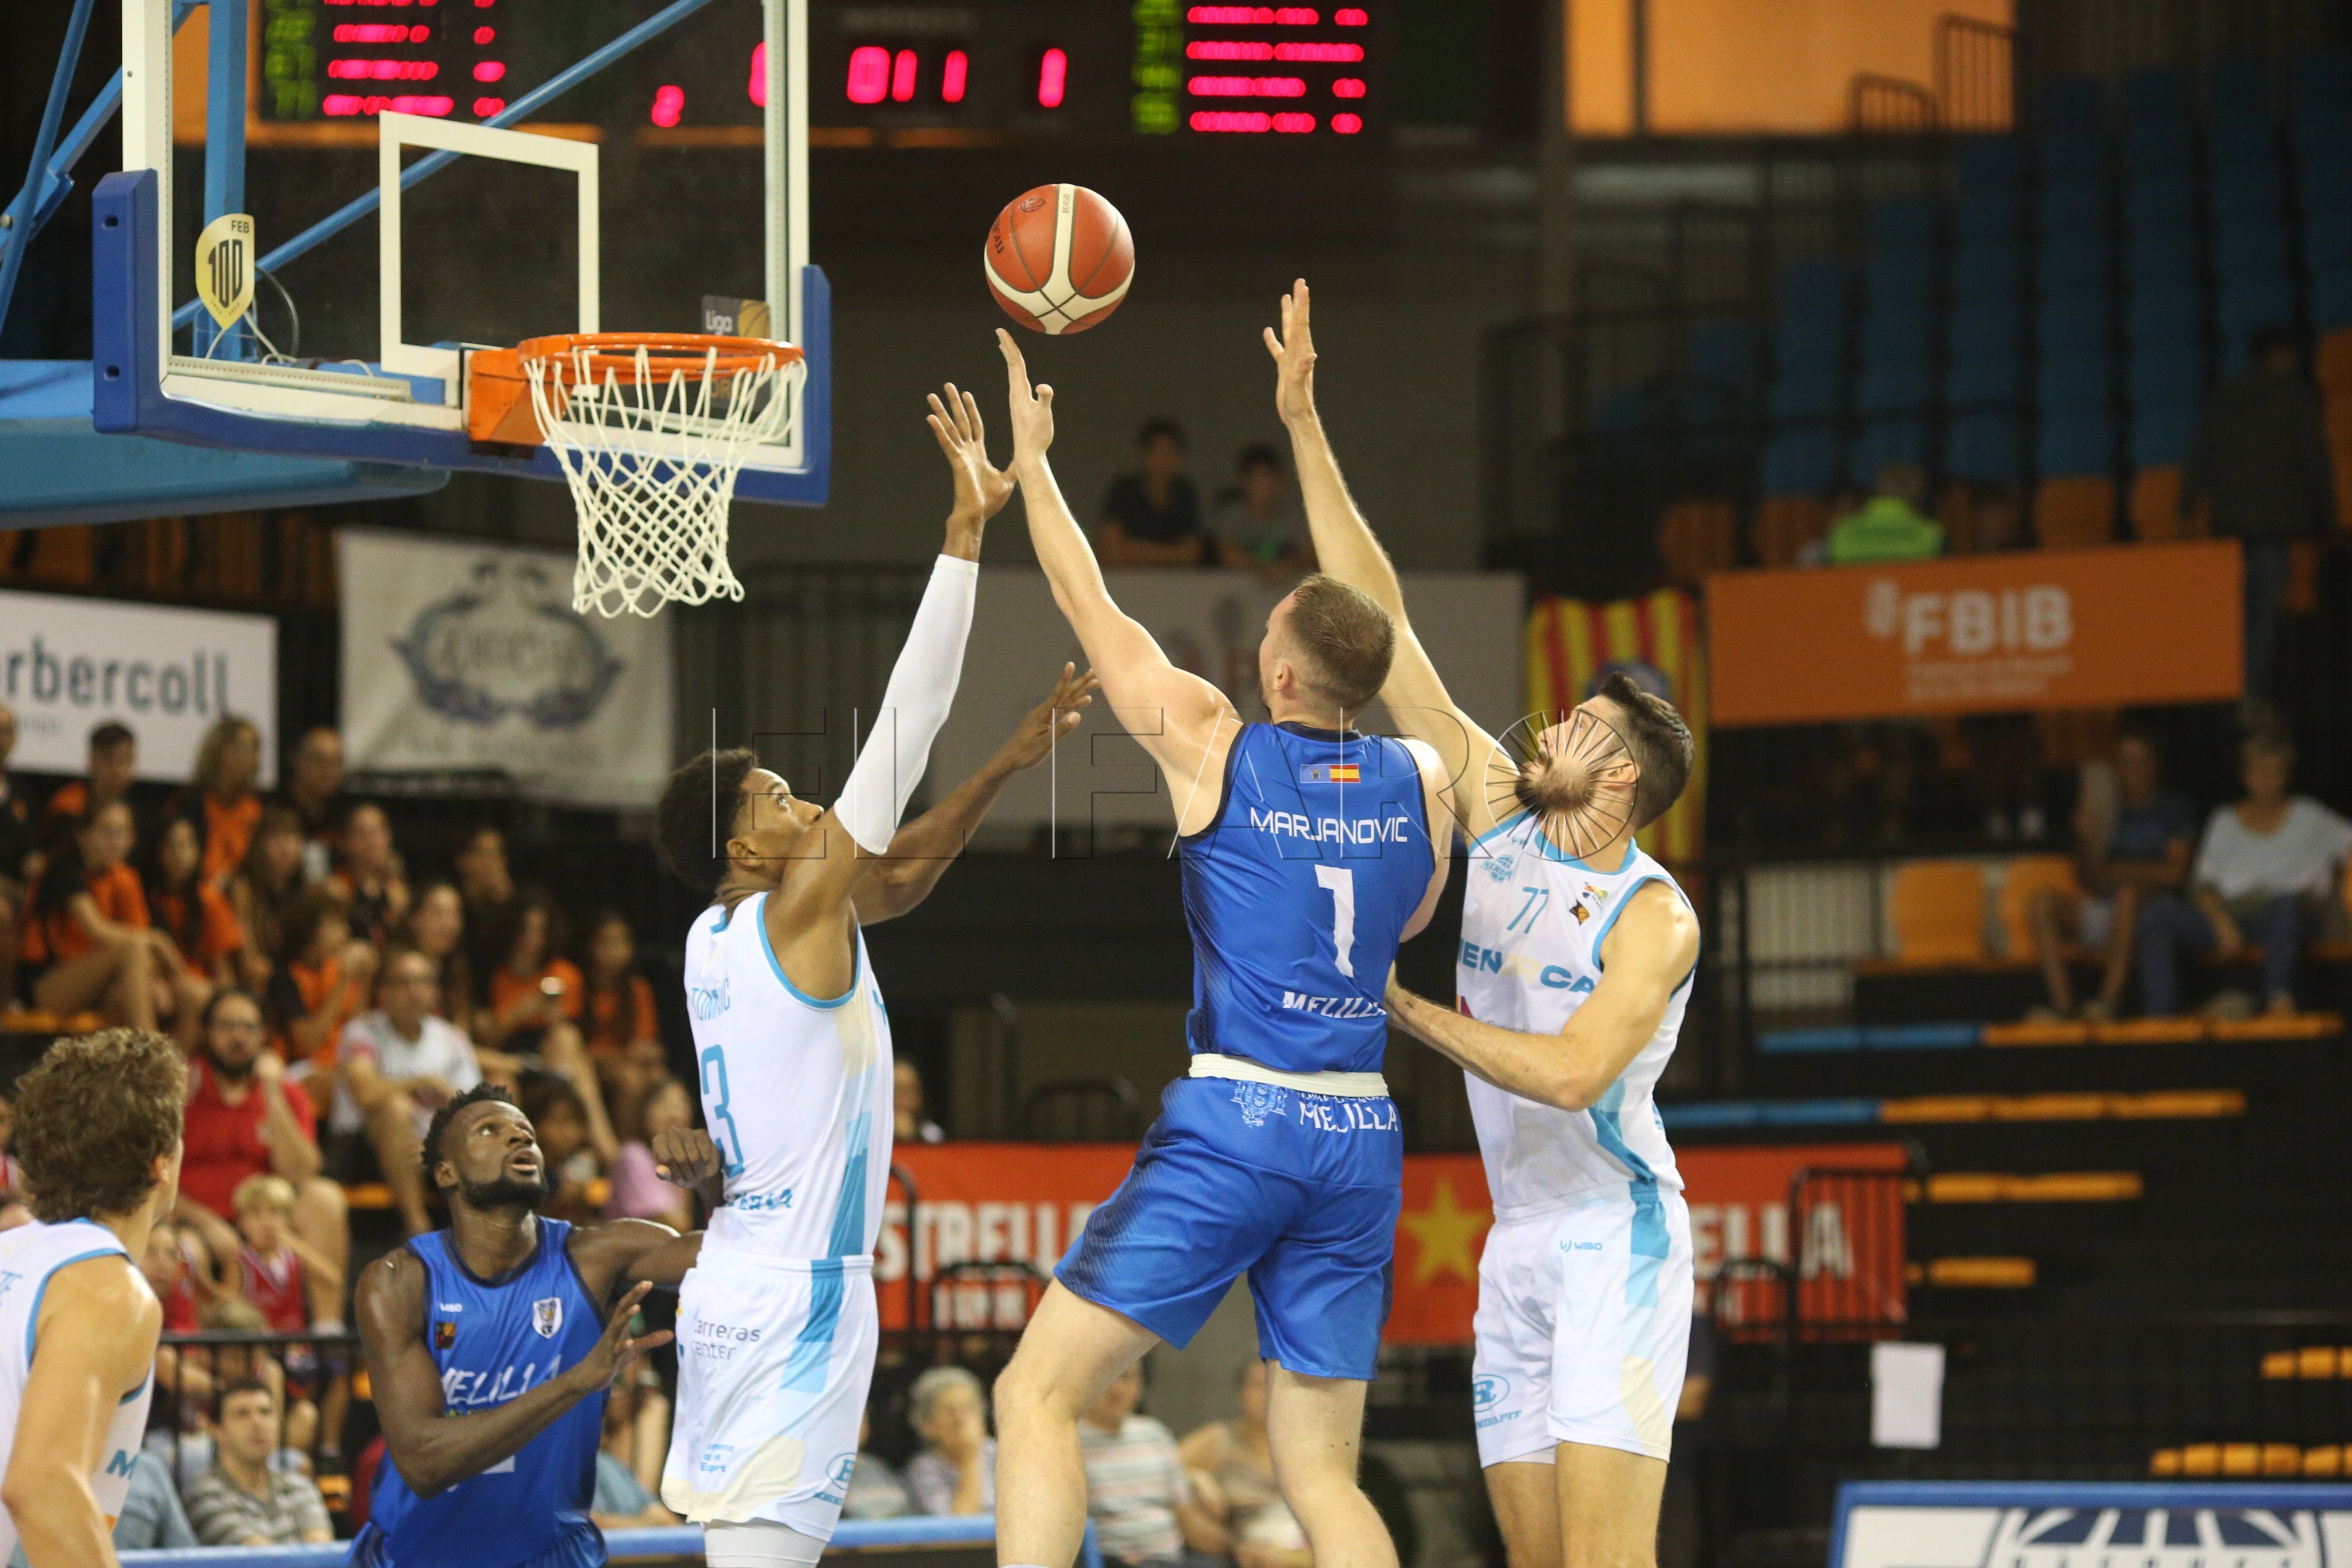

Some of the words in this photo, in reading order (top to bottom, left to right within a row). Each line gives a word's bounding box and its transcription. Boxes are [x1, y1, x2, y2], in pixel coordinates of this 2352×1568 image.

[231, 220, 250, 233] FEB
[208, 239, 243, 309] 100
[1904, 584, 2072, 658] FBIB
[1251, 806, 1408, 845] MARJANOVIC
[1314, 864, 1355, 978] 1
[1507, 886, 1548, 934] 77
[701, 1044, 745, 1179] 3
[1298, 1100, 1399, 1133] MELILLA
